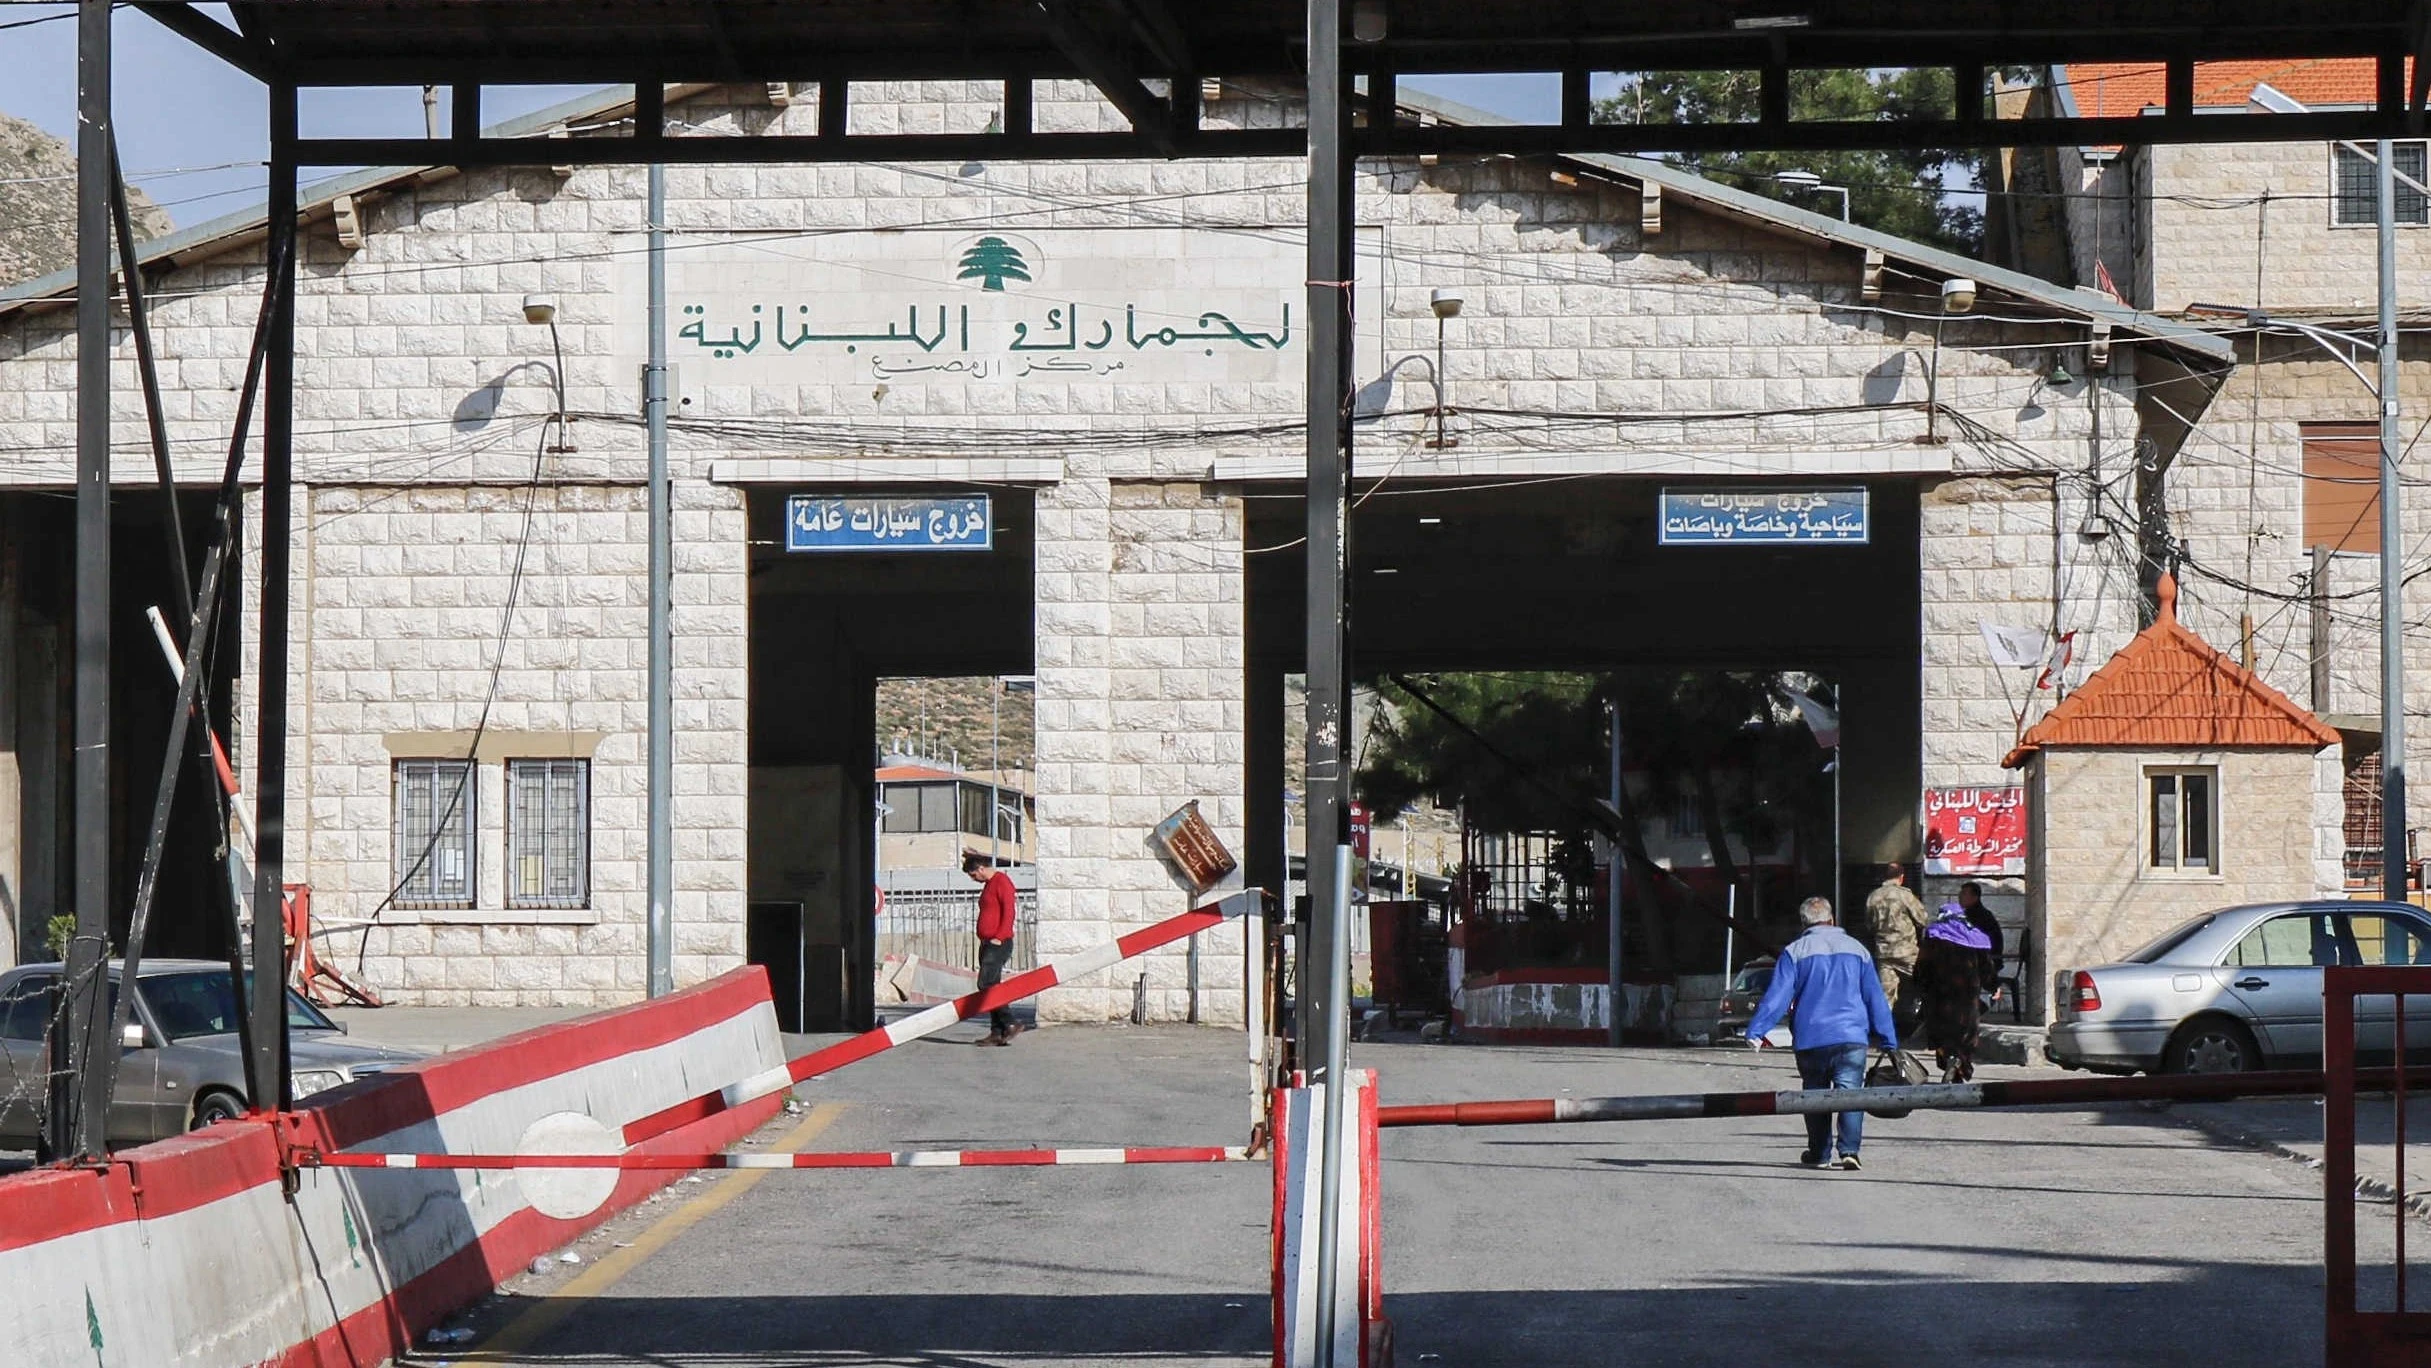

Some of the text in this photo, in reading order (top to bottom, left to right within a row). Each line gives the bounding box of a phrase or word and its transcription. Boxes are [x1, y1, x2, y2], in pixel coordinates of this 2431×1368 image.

[679, 303, 1290, 358] لجمارك اللبنانية
[871, 355, 1125, 379] مركز المصنع
[1700, 492, 1828, 513] خروج سيارات
[794, 500, 985, 544] خروج سيارات عامة
[1666, 512, 1863, 538] سياحية وخاصة وباصات
[1929, 789, 2024, 816] الجيش اللبناني
[1967, 838, 1999, 858] الشرطة
